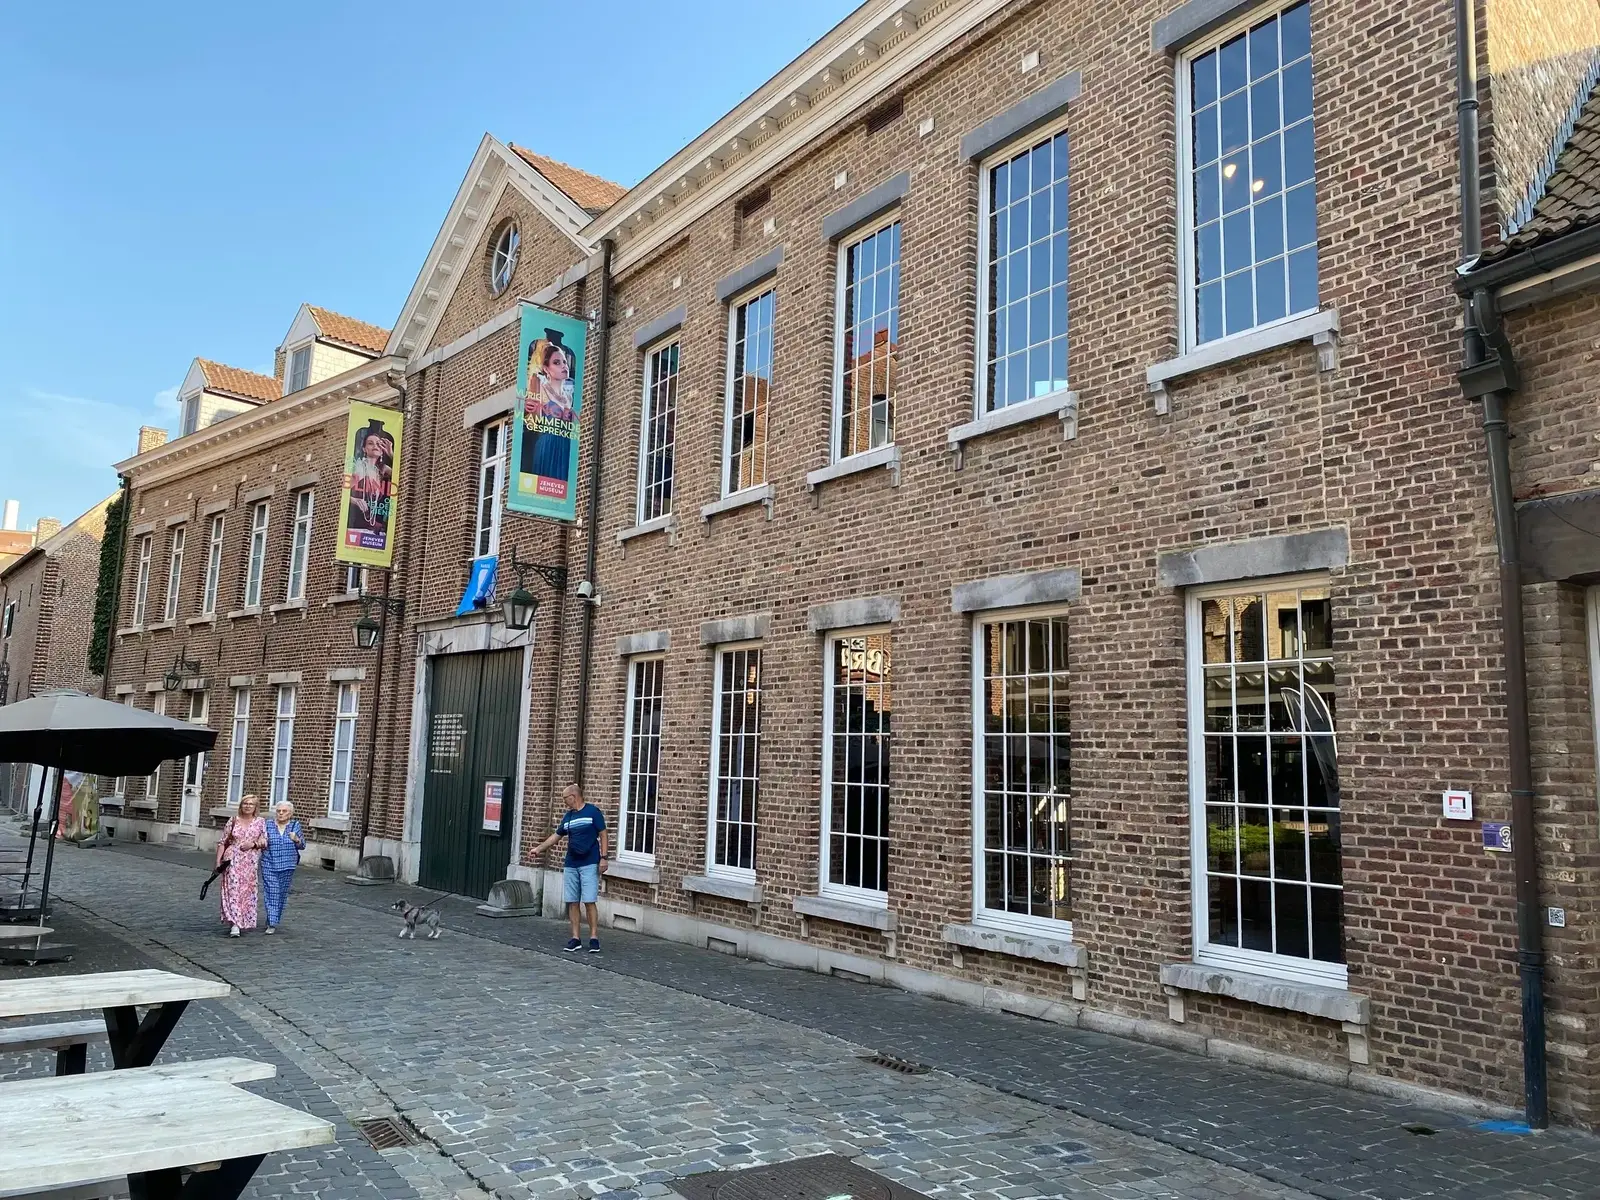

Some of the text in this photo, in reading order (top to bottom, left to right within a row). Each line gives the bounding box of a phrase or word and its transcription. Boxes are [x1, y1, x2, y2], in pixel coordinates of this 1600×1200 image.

[514, 411, 580, 433] VLAMMENDE
[526, 422, 580, 441] GESPREKKEN
[540, 480, 565, 489] JENEVER
[540, 486, 564, 494] MUSEUM
